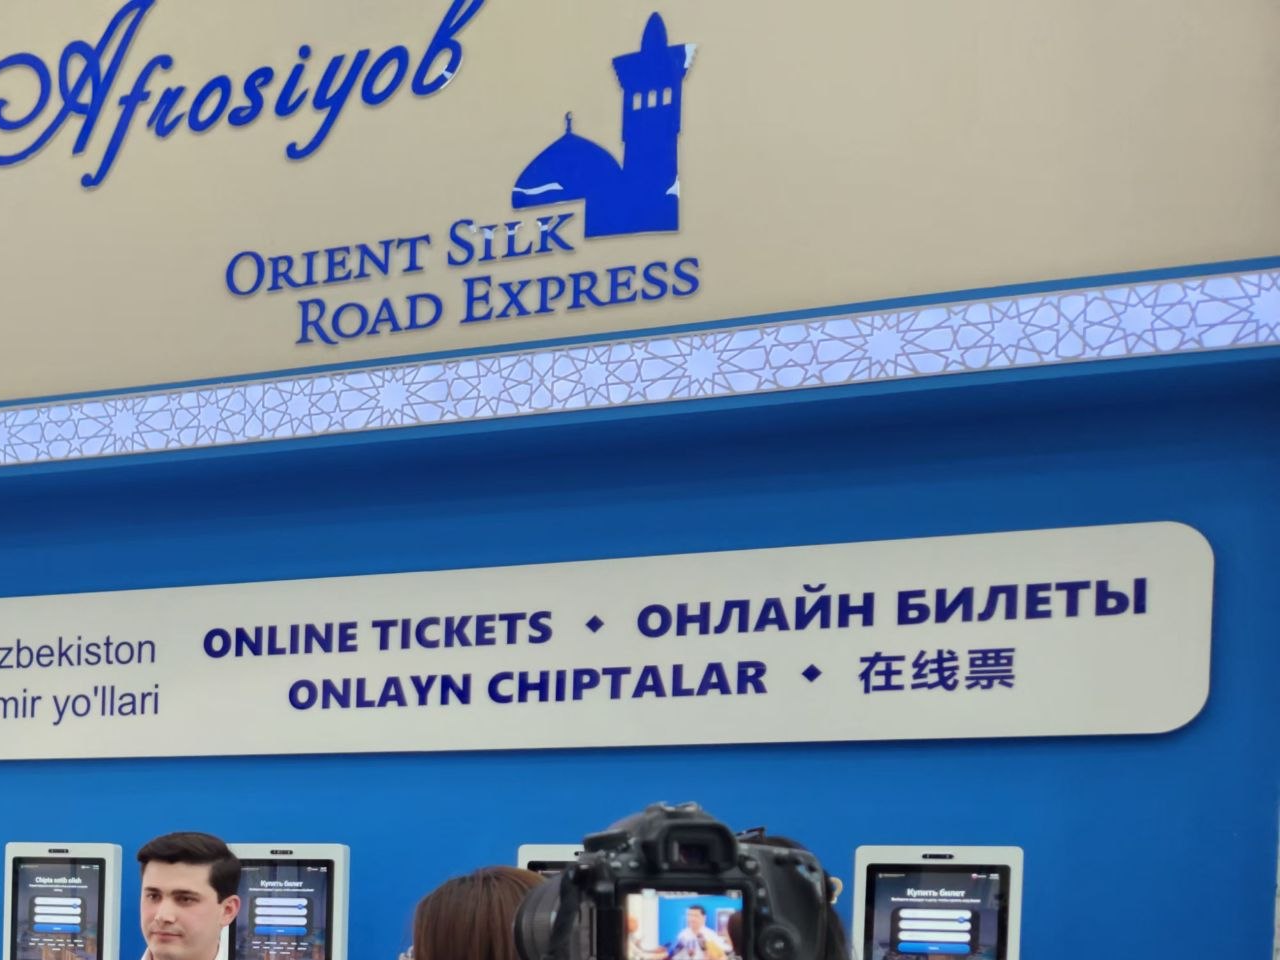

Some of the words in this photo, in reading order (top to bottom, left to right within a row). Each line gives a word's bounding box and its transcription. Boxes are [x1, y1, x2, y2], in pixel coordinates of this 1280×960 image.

[637, 583, 875, 638] ОНЛАЙН
[896, 577, 1148, 626] БИЛЕТЫ
[202, 621, 358, 659] ONLINE
[371, 611, 553, 651] TICKETS
[288, 673, 472, 711] ONLAYN
[487, 660, 768, 705] CHIPTALAR
[858, 647, 1017, 695] 在线票
[52, 685, 159, 726] yo'llari
[260, 880, 283, 888] Купить
[906, 888, 938, 898] Купить
[939, 888, 966, 897] билет
